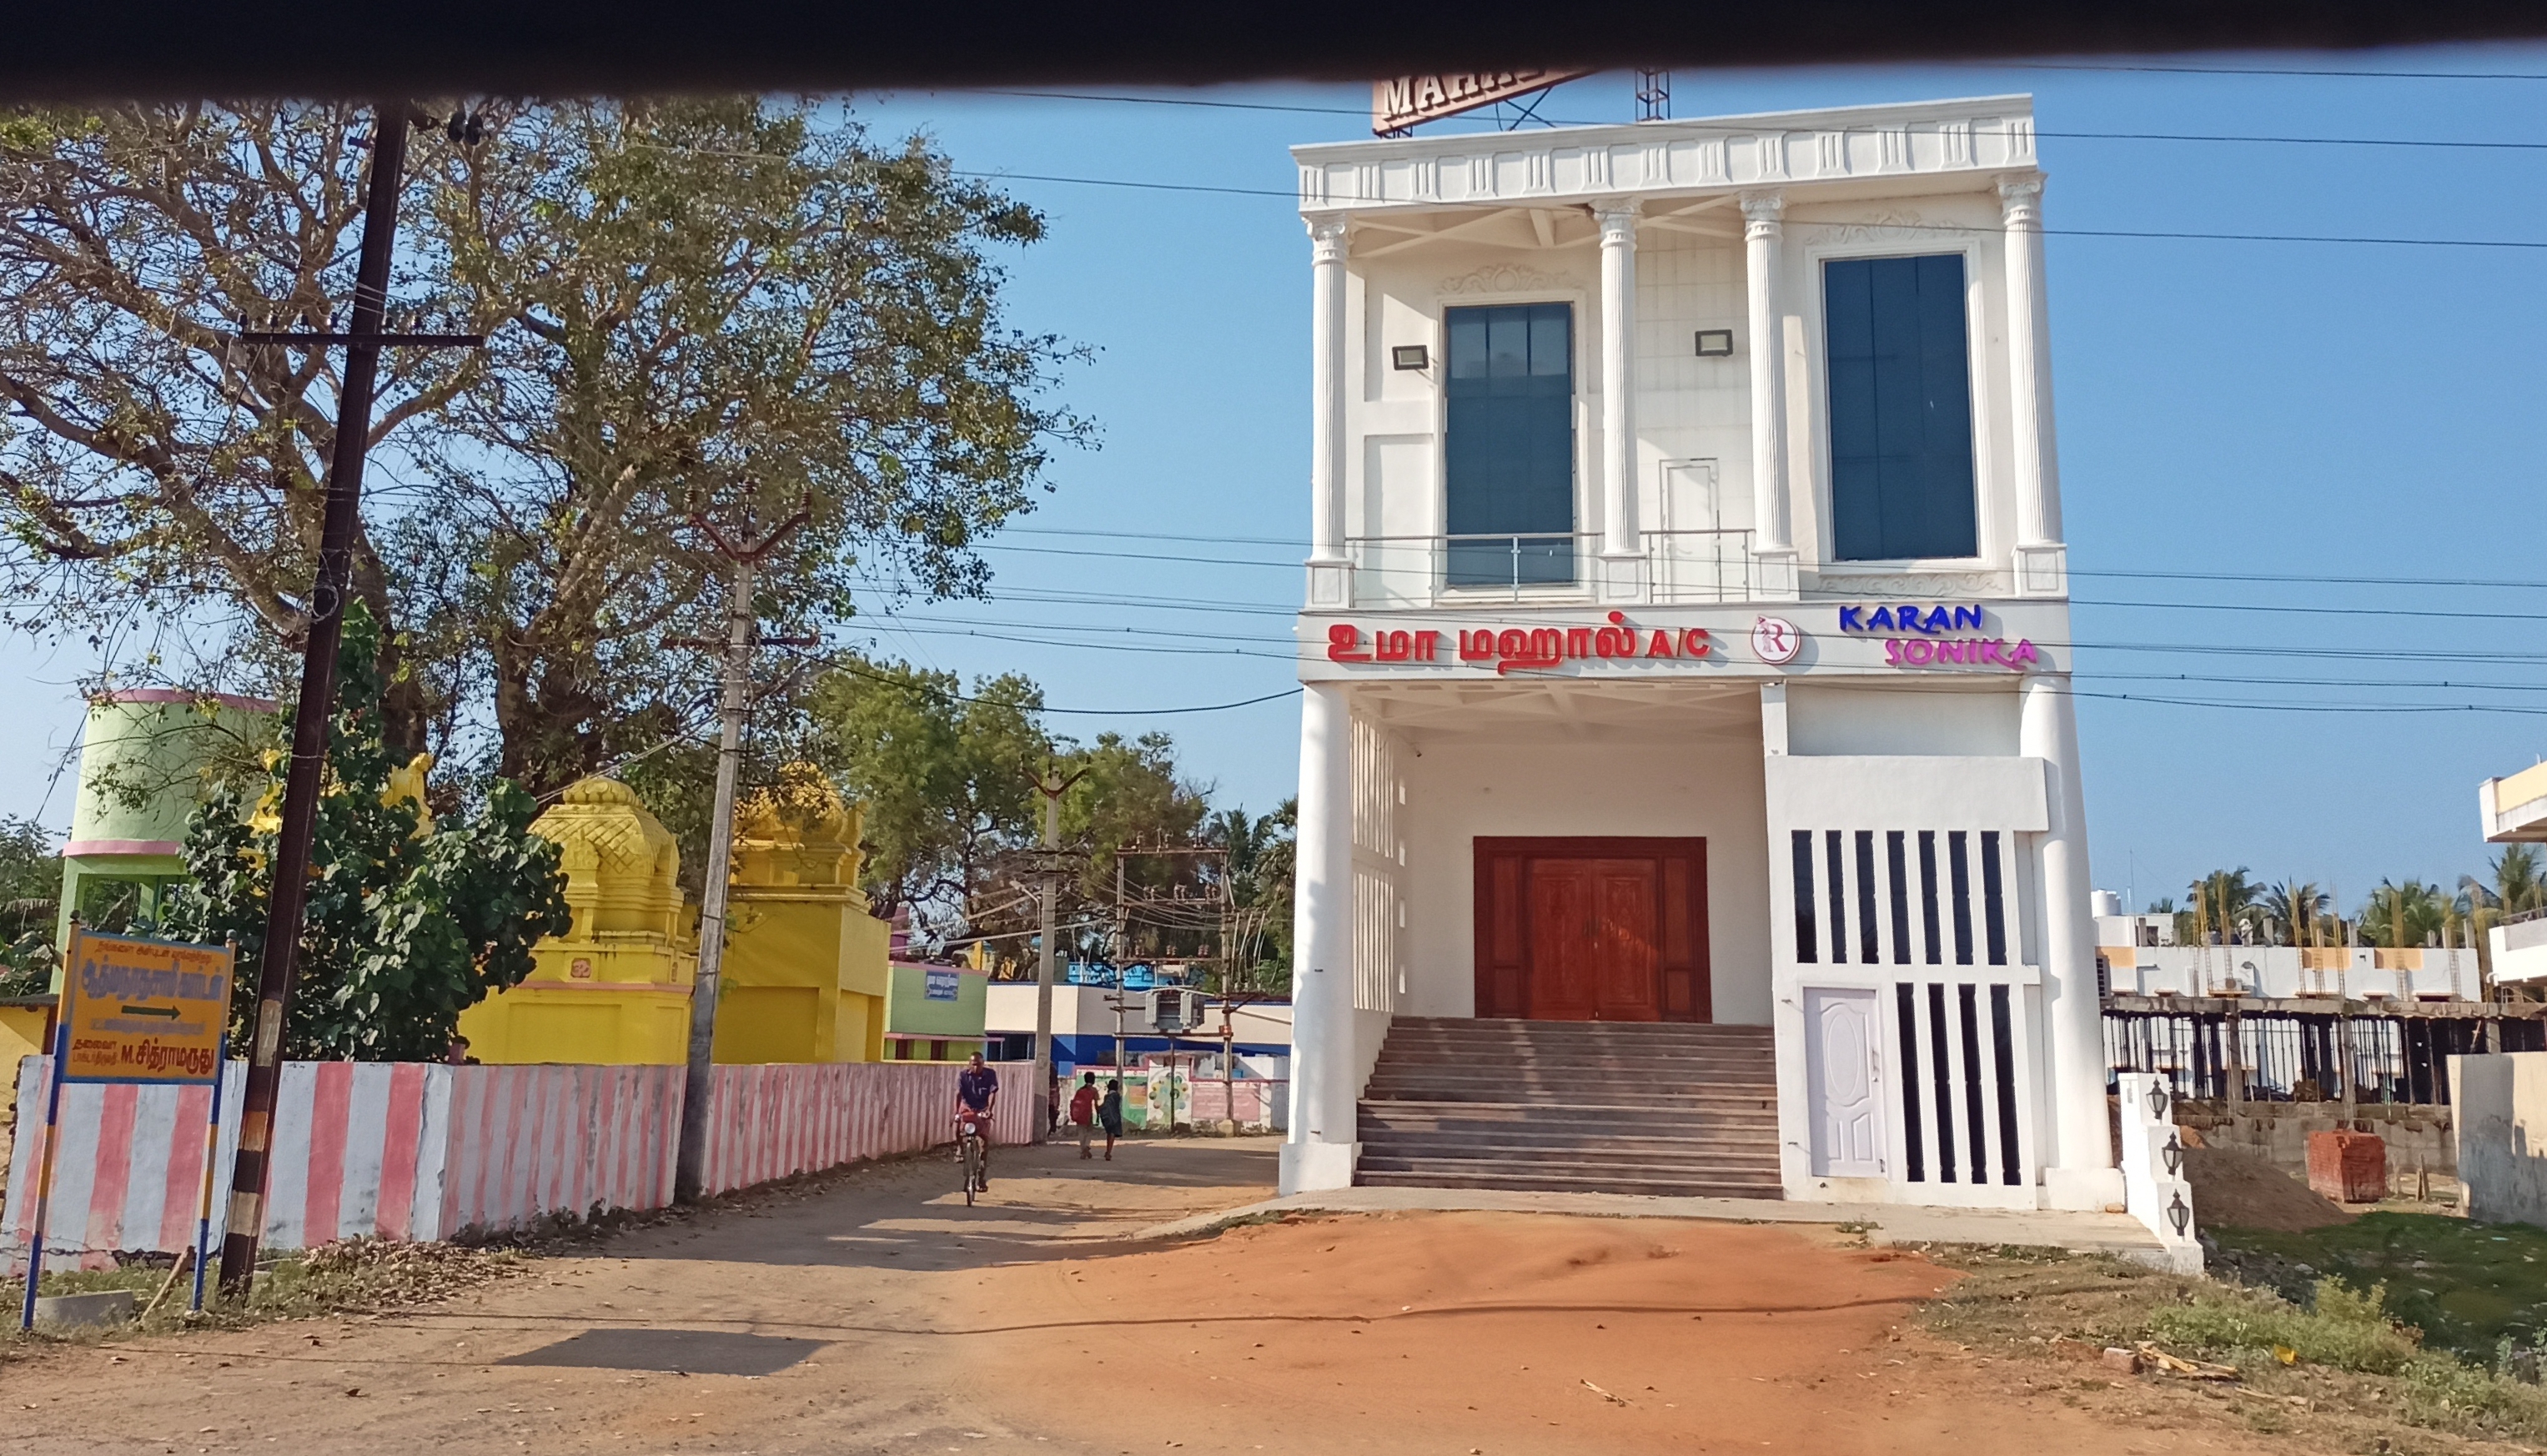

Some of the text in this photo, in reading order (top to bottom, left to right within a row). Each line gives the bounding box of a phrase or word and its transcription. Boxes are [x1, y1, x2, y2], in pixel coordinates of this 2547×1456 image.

[1380, 71, 1543, 120] MAH
[1840, 604, 1982, 635] KARAN
[1328, 624, 1439, 661] உமா
[1459, 610, 1637, 675] மஹால்
[1885, 638, 2037, 670] SONIKA
